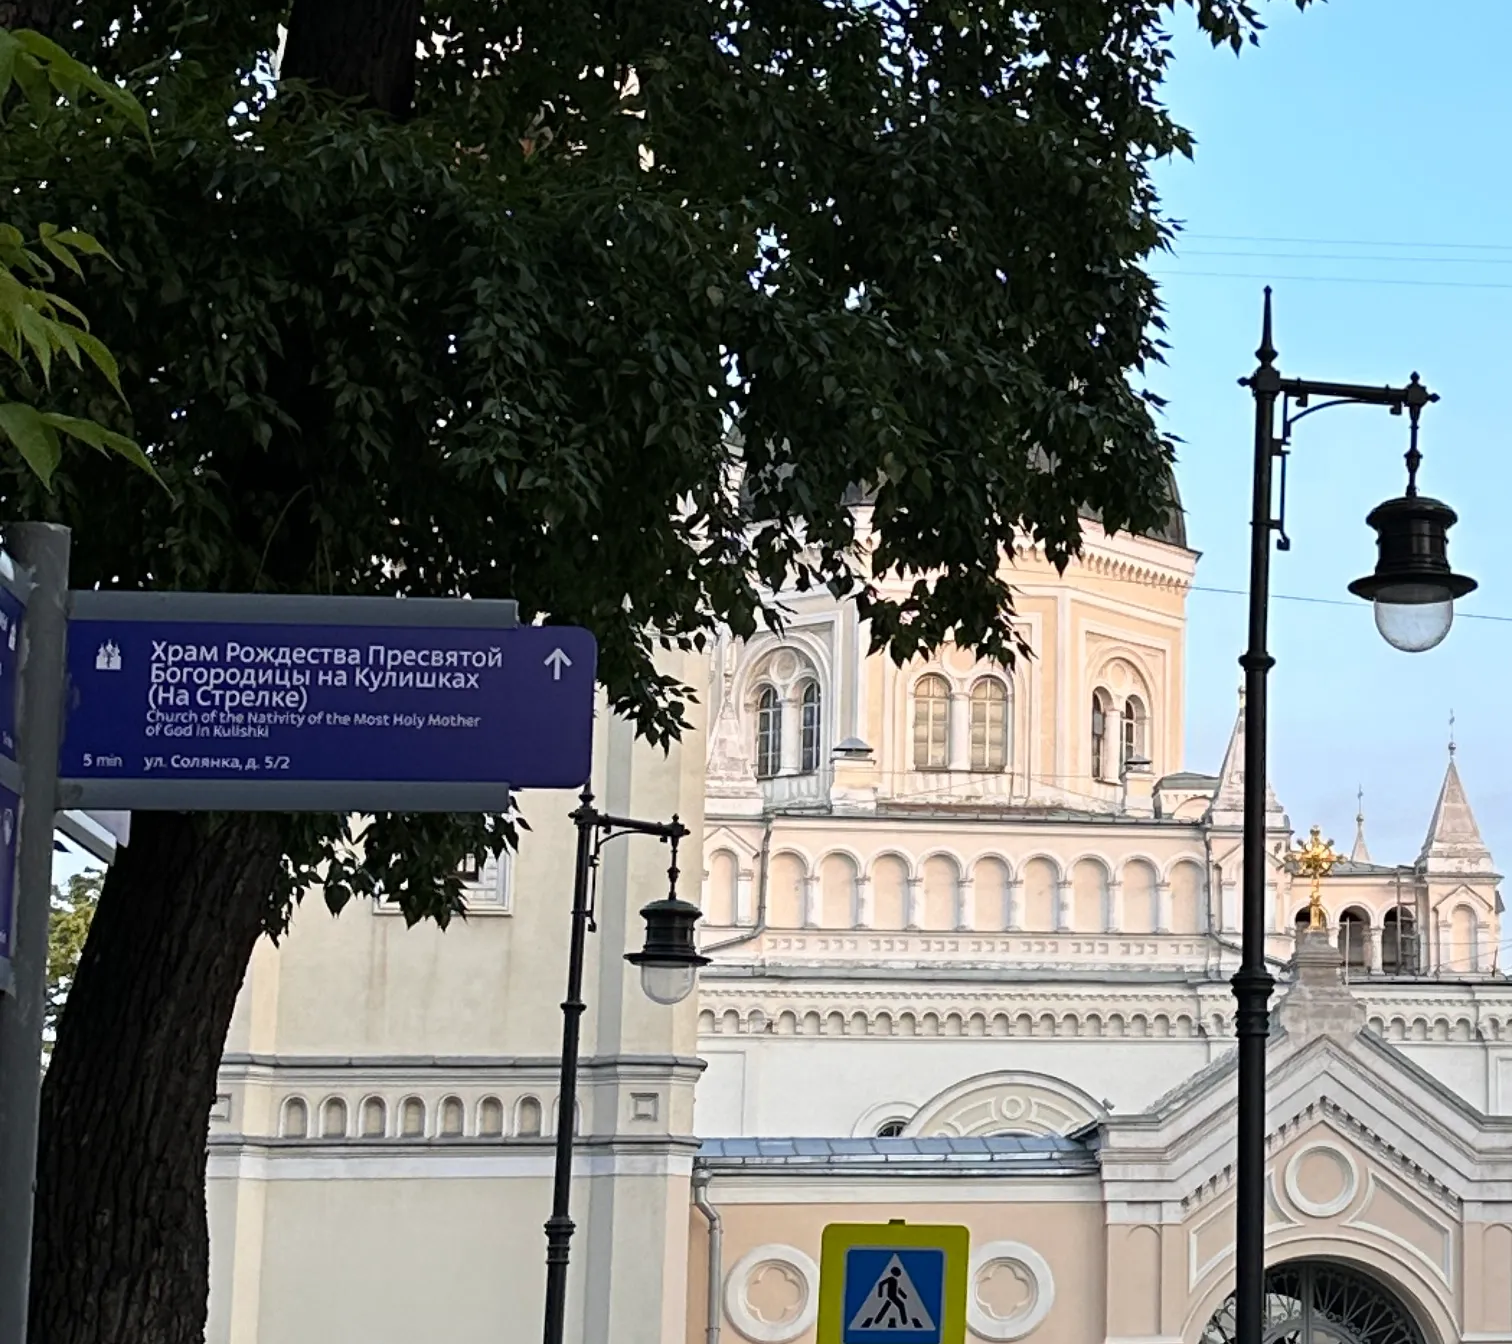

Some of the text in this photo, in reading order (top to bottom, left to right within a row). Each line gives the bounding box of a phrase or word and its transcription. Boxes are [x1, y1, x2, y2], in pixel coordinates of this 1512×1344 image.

[151, 640, 503, 670] Храм Рождества Пресвятой
[151, 663, 480, 692] Богородицы на Кулишках
[148, 684, 307, 712] (На Стрелке)
[146, 709, 482, 729] Church of the Nativity of the Most Holy Mother
[145, 723, 269, 738] of God in Kulishki
[83, 753, 123, 767] 5 min
[144, 754, 290, 771] ул. Солянка, д. 5/2
